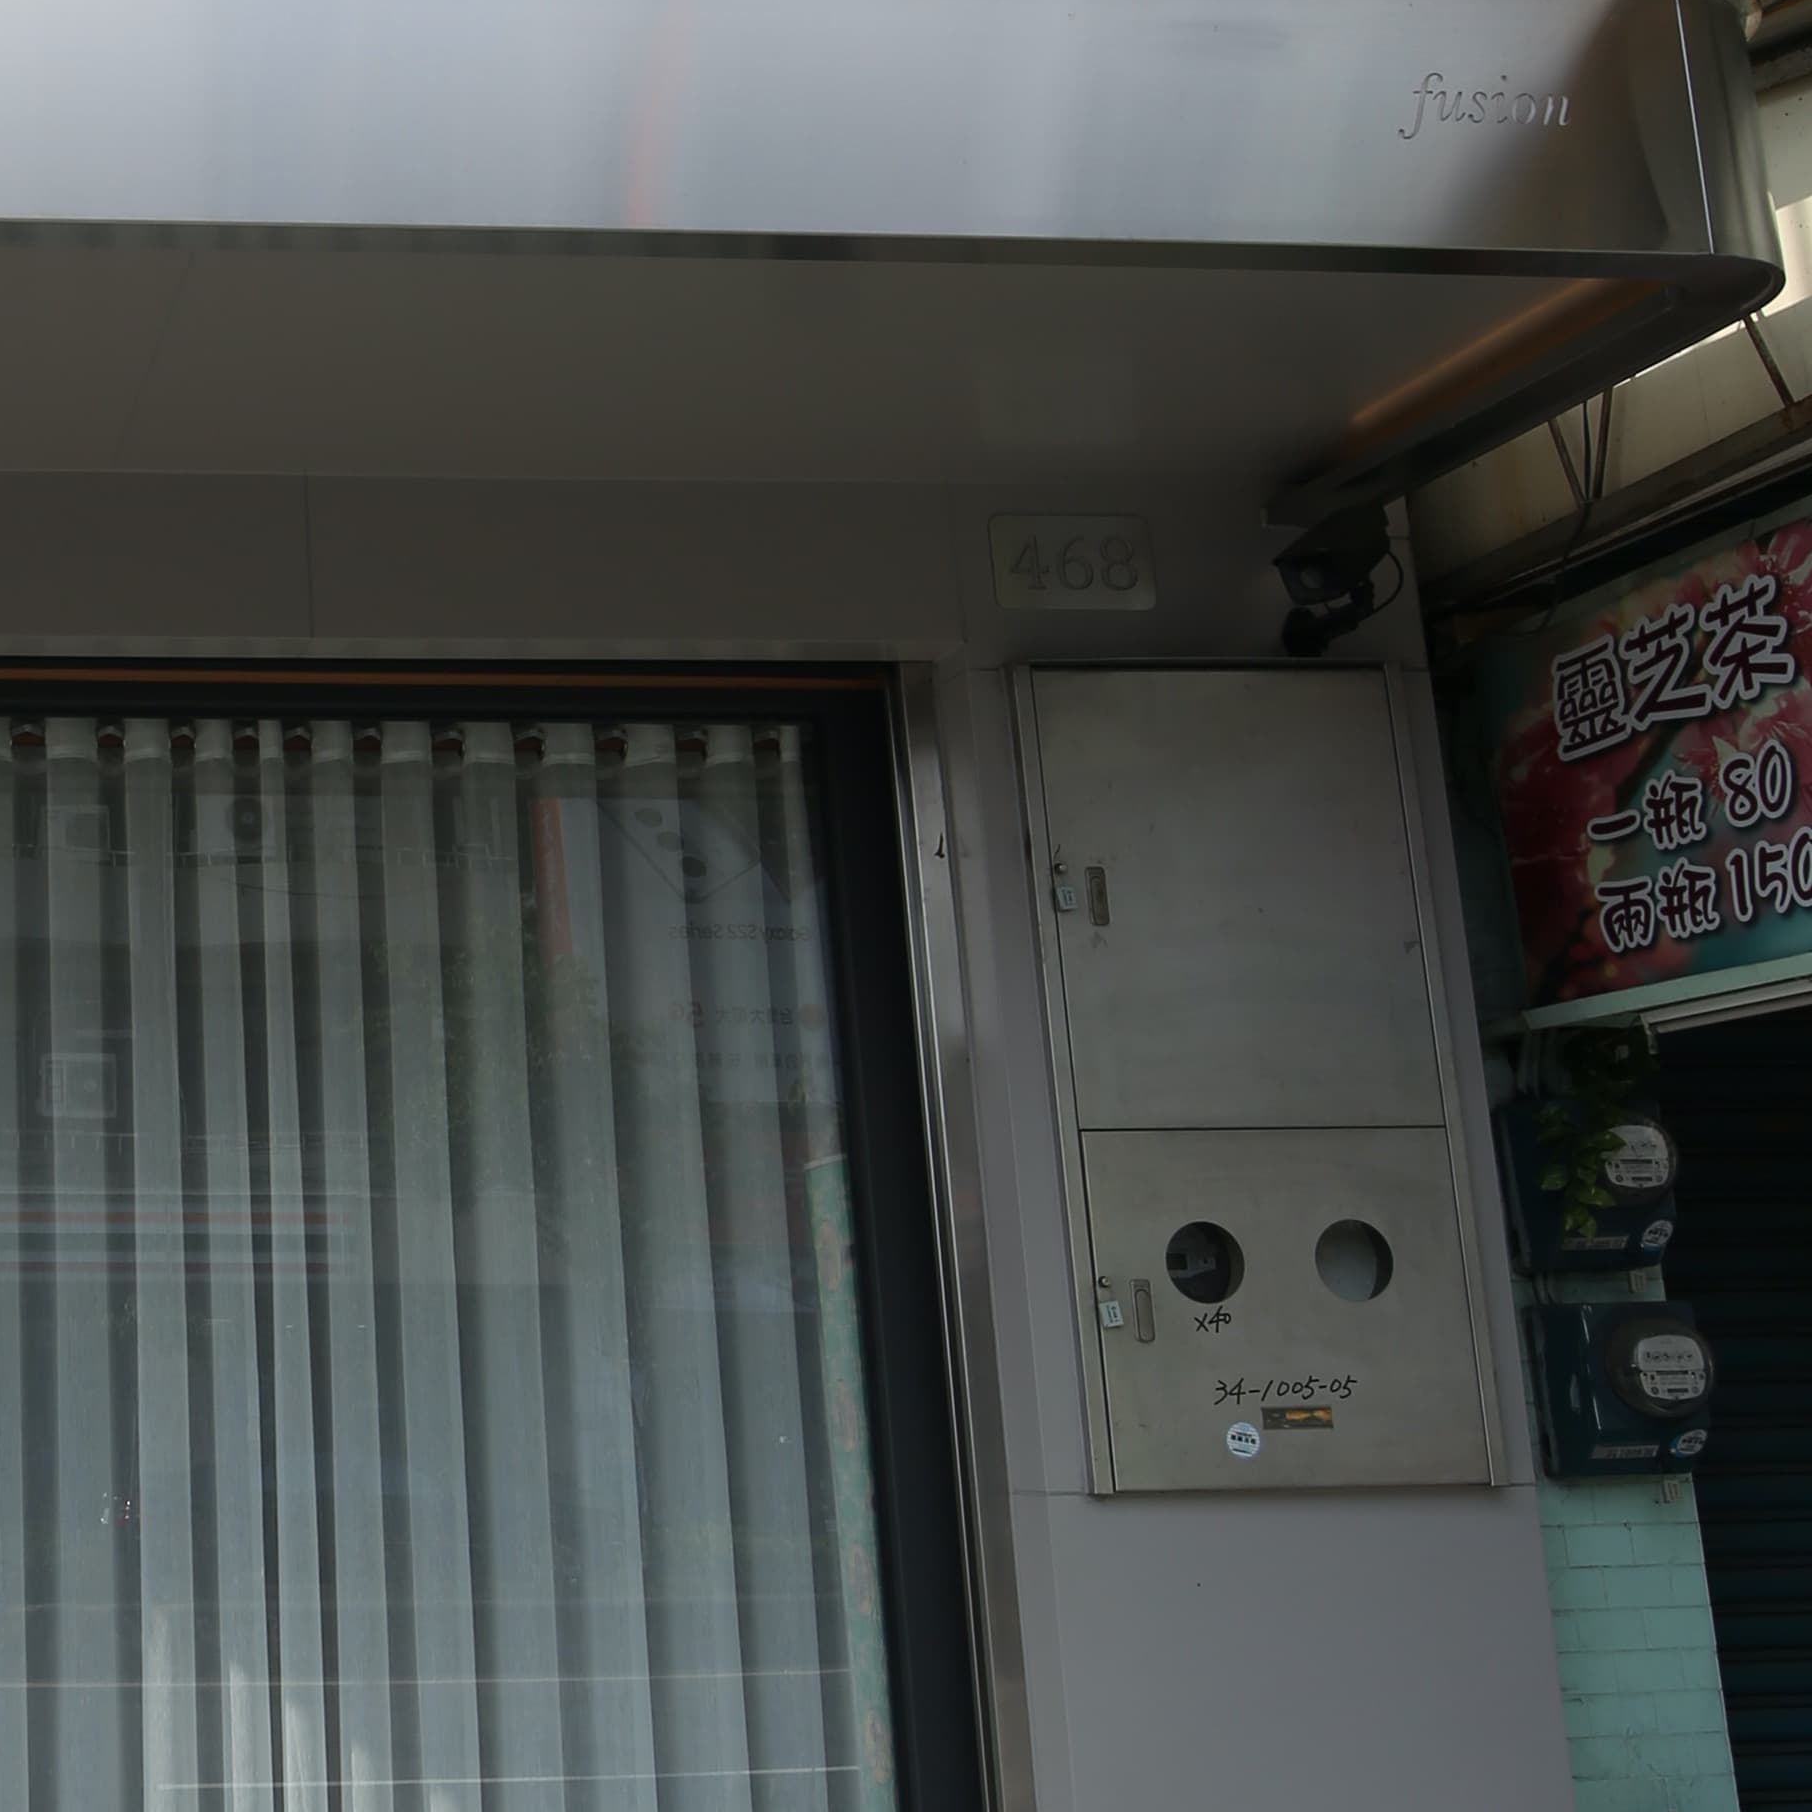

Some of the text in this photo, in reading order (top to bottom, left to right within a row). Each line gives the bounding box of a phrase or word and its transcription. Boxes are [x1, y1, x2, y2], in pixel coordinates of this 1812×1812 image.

[1396, 72, 1572, 140] fusion
[1008, 533, 1139, 592] 468
[1553, 578, 1793, 757] 靈芝茶
[1589, 742, 1791, 848] 一瓶 80
[1596, 829, 1812, 950] 兩瓶 150
[1213, 1374, 1358, 1405] 34-1005-05
